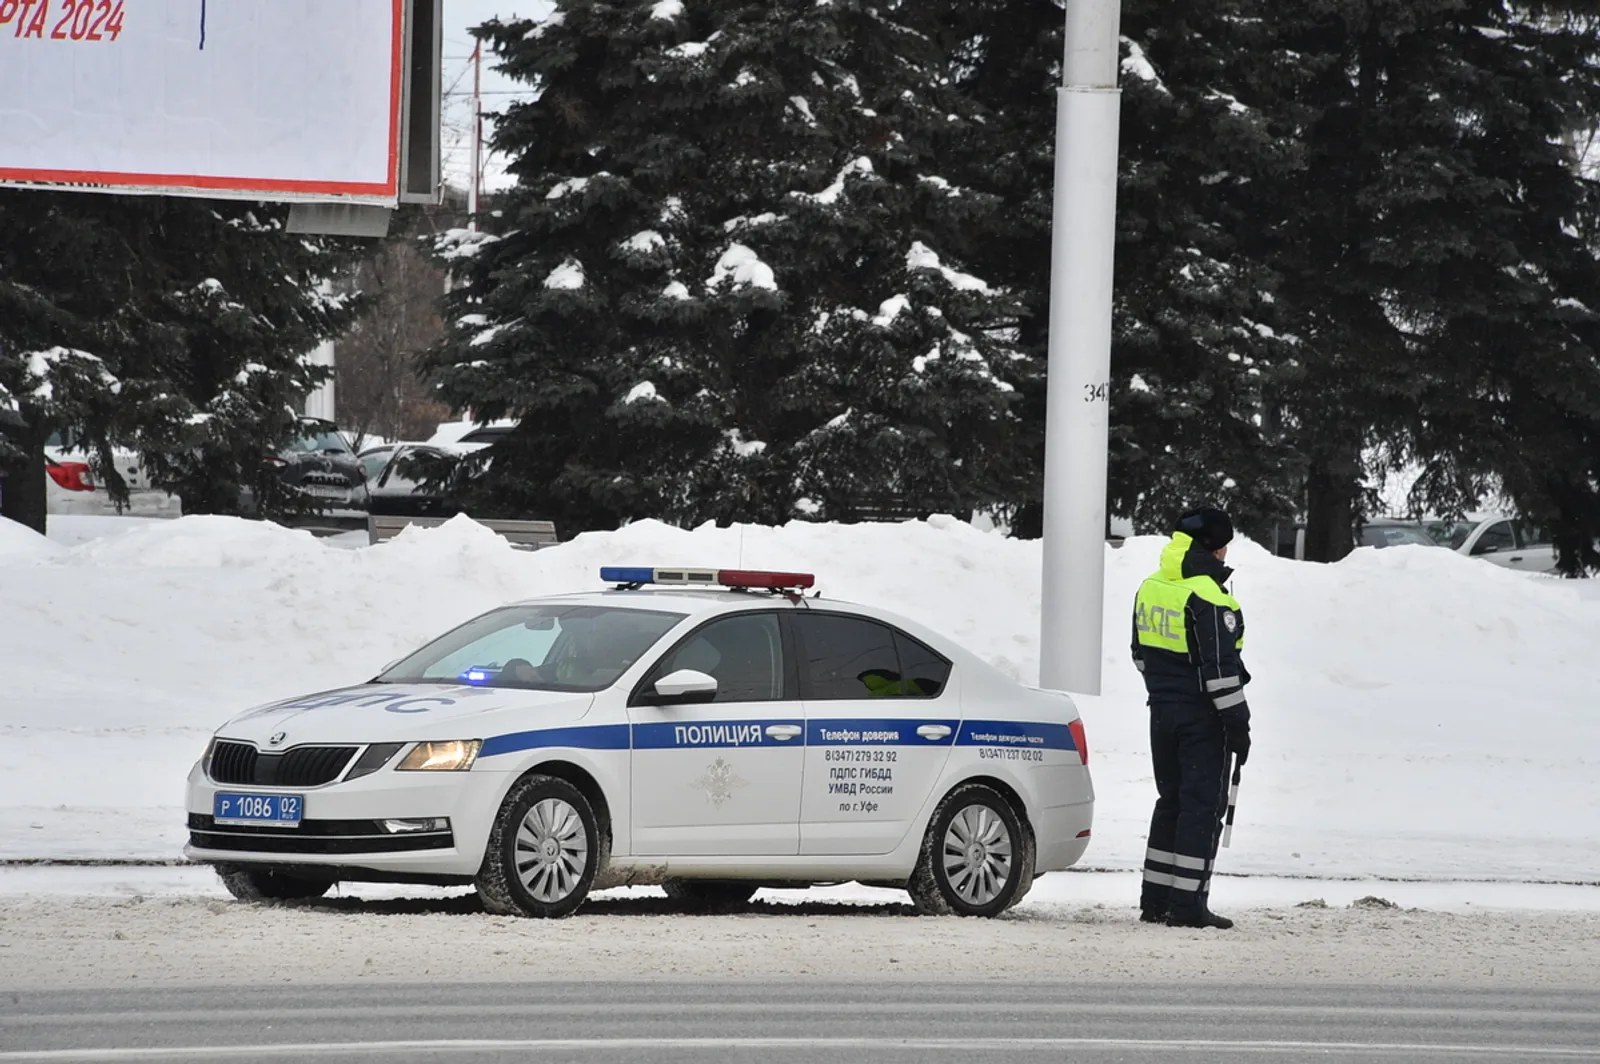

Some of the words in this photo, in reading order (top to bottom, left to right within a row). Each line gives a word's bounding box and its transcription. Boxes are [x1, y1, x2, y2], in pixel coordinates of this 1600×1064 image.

[50, 0, 125, 41] 2024
[1136, 602, 1181, 640] ДПС
[674, 724, 762, 746] ПОЛИЦИЯ
[820, 728, 860, 742] Телефон
[862, 730, 900, 742] доверия
[859, 768, 892, 780] ГИБДД
[828, 783, 857, 795] УМВД
[859, 784, 893, 794] России
[237, 797, 272, 817] 1086
[281, 798, 297, 813] 02
[839, 803, 851, 811] по
[852, 803, 859, 811] г.
[860, 801, 878, 813] Уфе
